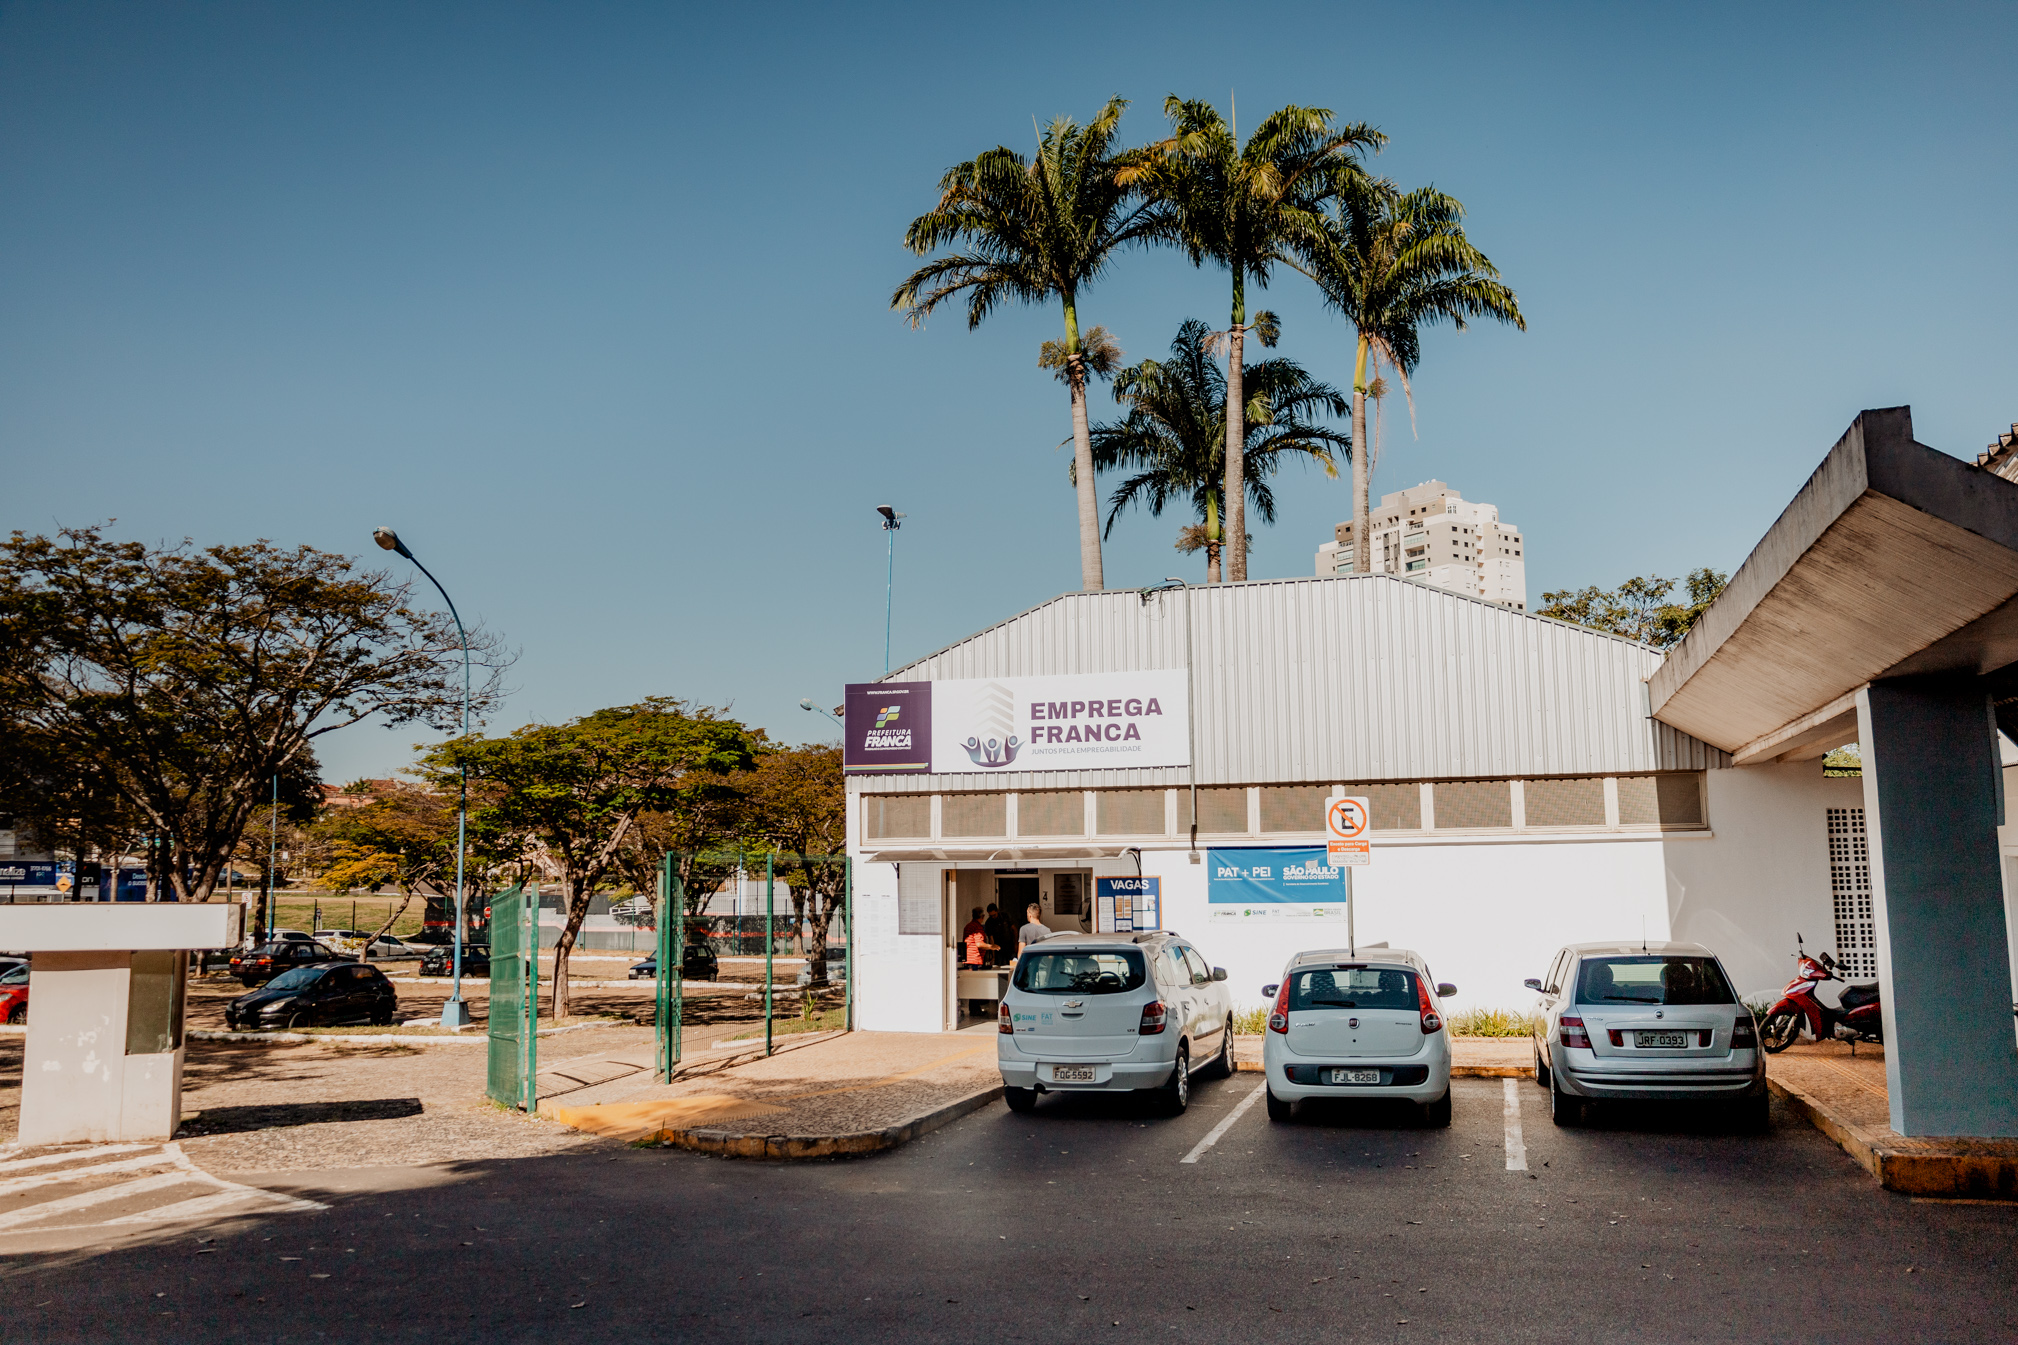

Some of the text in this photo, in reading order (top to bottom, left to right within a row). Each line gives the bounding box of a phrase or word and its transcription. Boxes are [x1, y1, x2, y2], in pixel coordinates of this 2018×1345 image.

[1031, 697, 1163, 721] EMPREGA
[867, 729, 912, 737] PREFEITURA
[1031, 723, 1141, 744] FRANCA
[864, 736, 912, 748] FRANCA
[1076, 745, 1142, 753] EMPREGABILIDADE
[1217, 866, 1239, 877] PAT
[1252, 866, 1271, 877] PEI
[1283, 865, 1339, 876] SÃO PAULO
[1110, 879, 1150, 890] VAGAS
[1041, 1012, 1053, 1020] FAT
